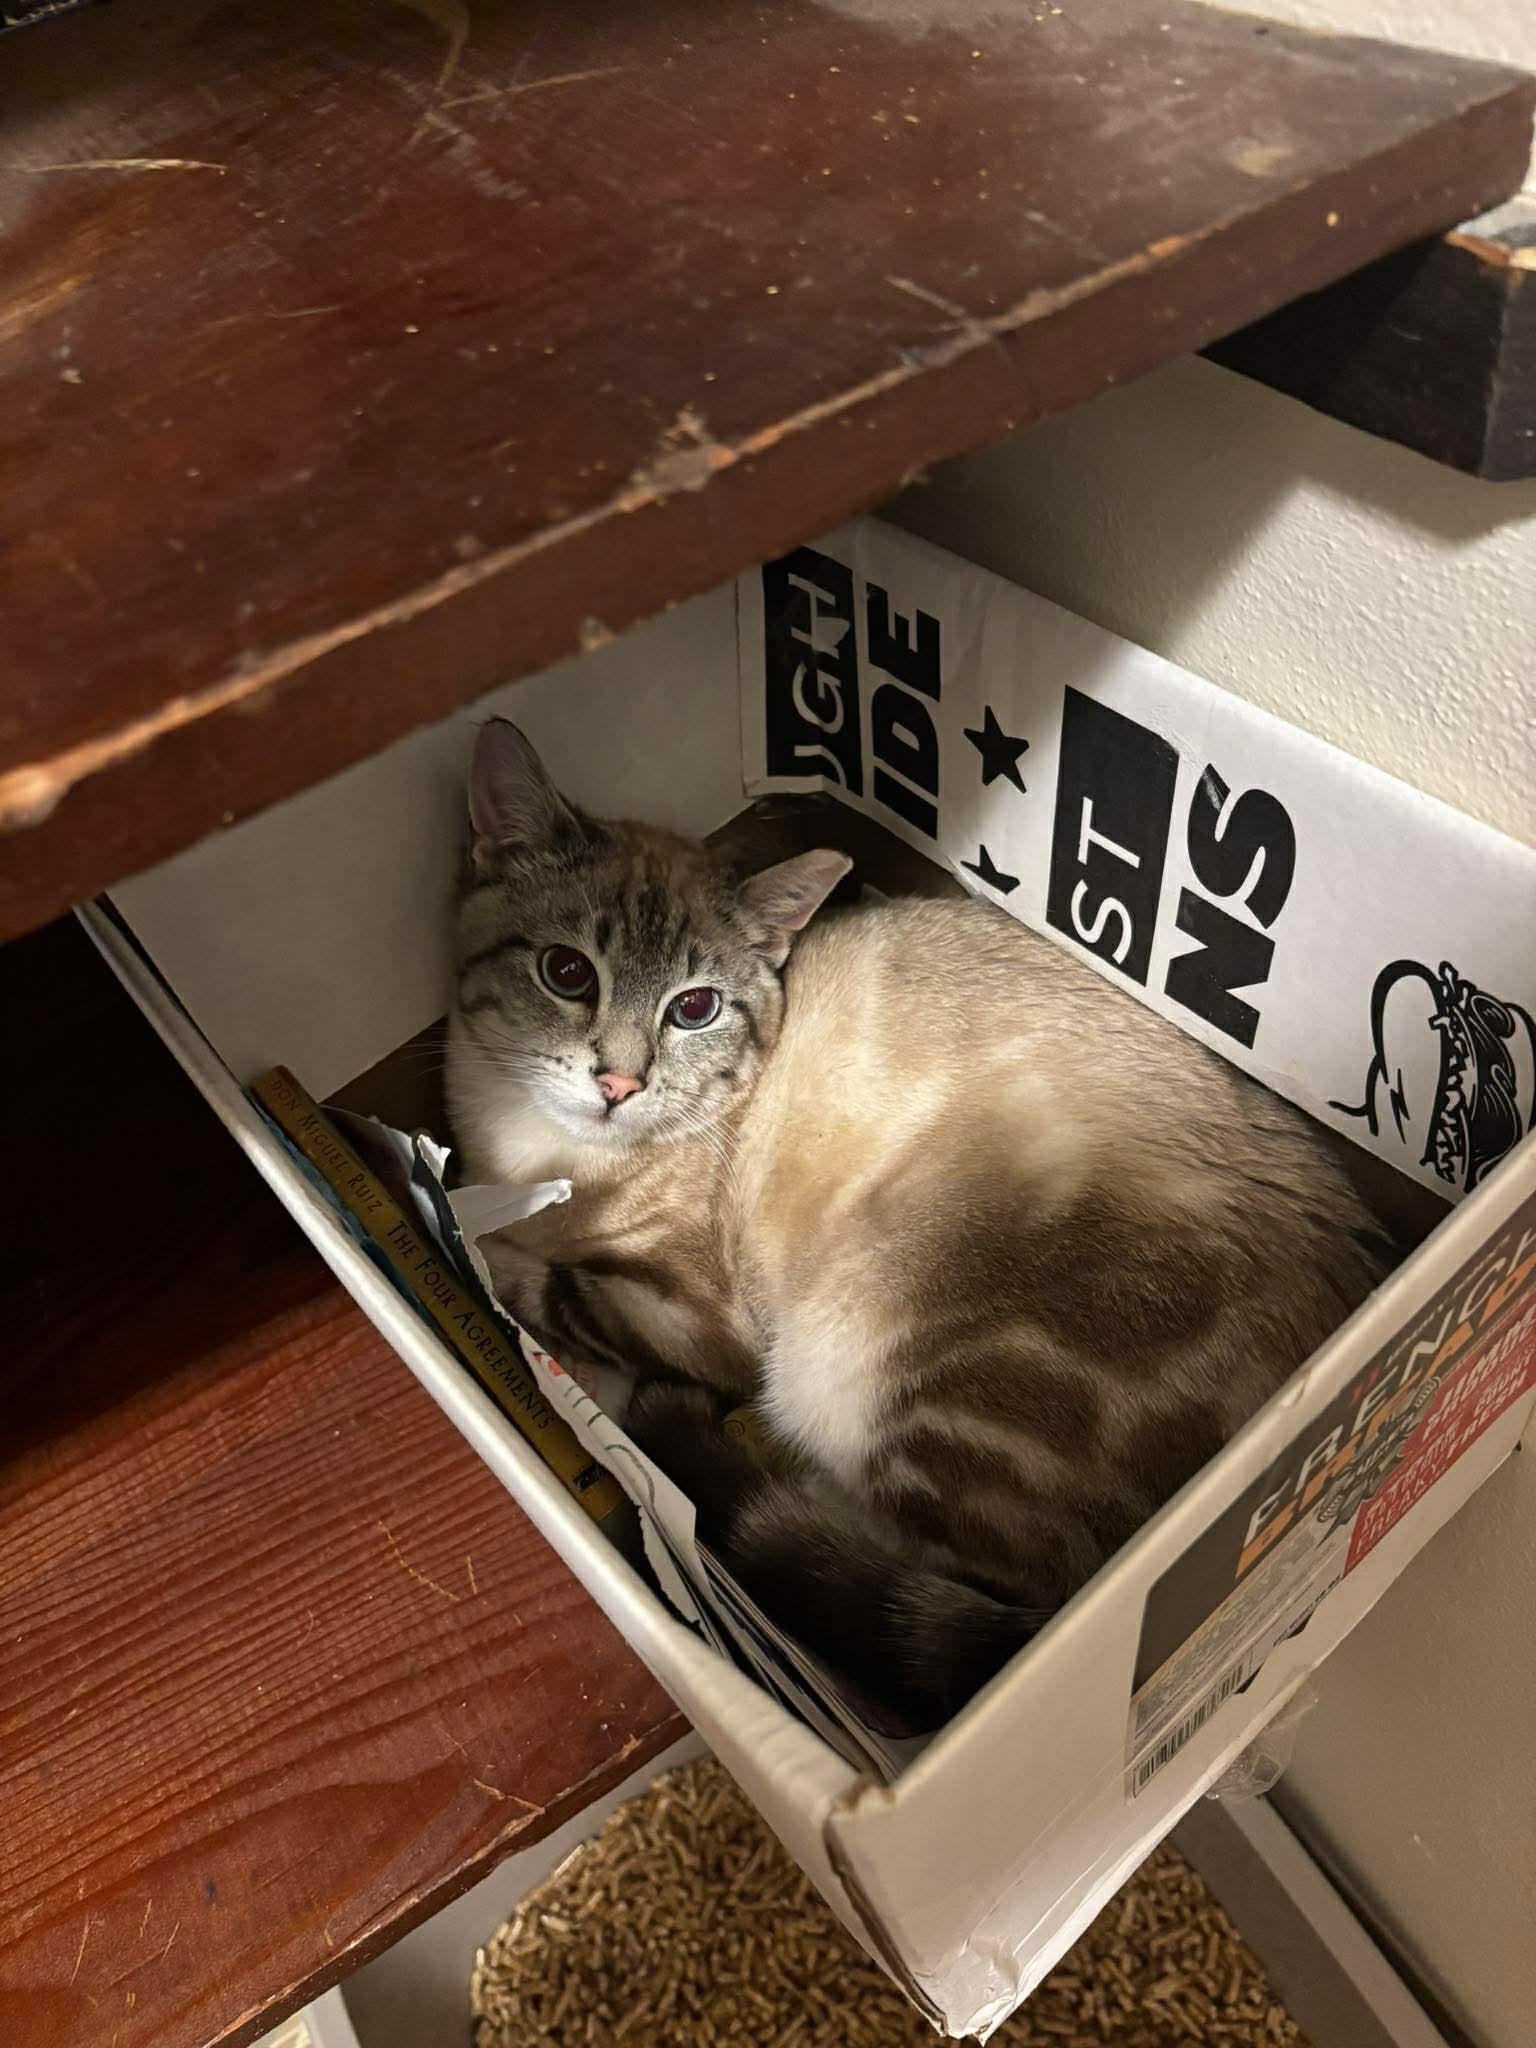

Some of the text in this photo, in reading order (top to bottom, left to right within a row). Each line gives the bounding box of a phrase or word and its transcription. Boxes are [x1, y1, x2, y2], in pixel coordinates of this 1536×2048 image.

[1070, 796, 1141, 966] ST
[1164, 762, 1296, 1050] NS
[270, 1078, 556, 1431] DON MIGUEL RUIZ THE FOUR AGREEMENTS
[1356, 1453, 1442, 1554] FREAKY
[1447, 1366, 1527, 1459] FRESH
